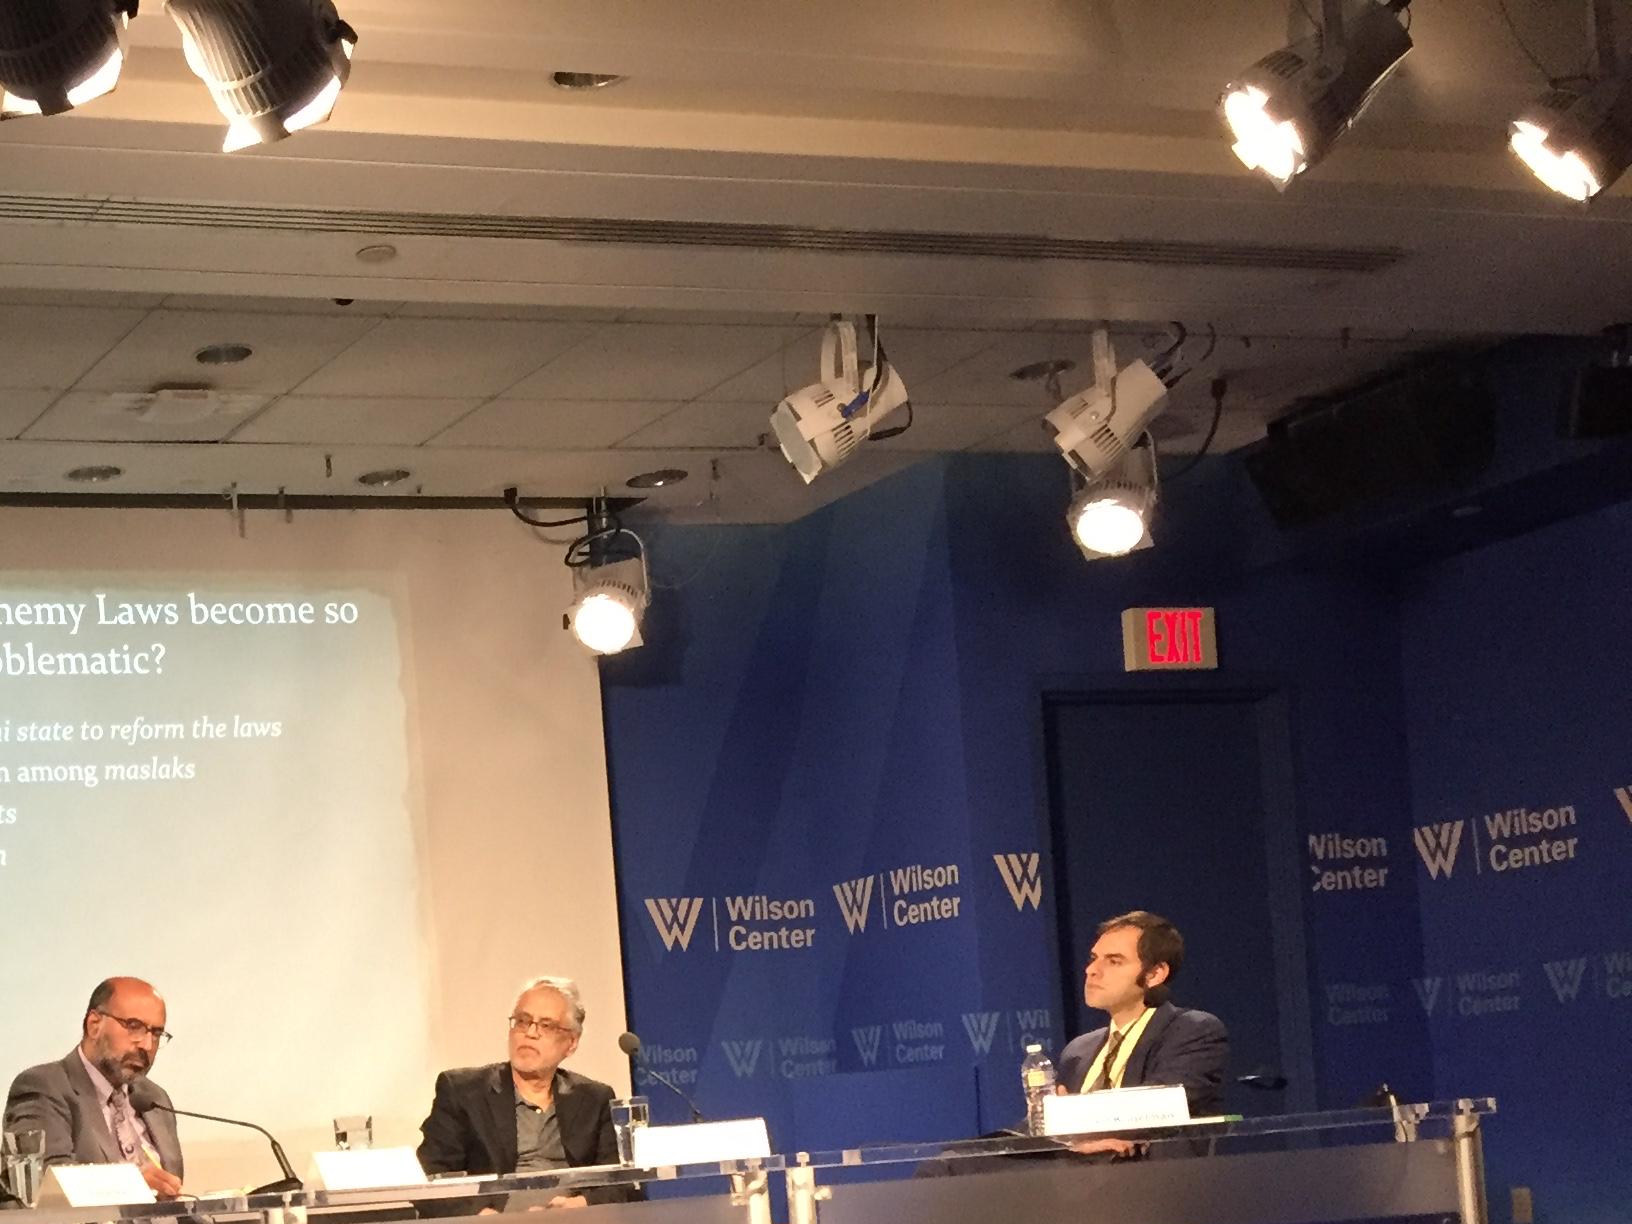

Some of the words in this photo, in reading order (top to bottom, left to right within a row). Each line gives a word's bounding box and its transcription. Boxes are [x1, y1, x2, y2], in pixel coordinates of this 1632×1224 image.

[96, 592, 179, 626] Laws
[187, 591, 315, 625] become
[325, 602, 359, 625] so
[1146, 610, 1202, 664] EXIT
[16, 720, 74, 744] state
[80, 721, 104, 743] to
[109, 716, 185, 746] reform
[192, 717, 228, 742] the
[232, 715, 282, 740] laws
[17, 765, 99, 788] among
[104, 757, 196, 783] maslaks
[1484, 805, 1576, 841] Wilson
[1488, 836, 1578, 872] Center
[889, 864, 959, 897] Wilson
[725, 895, 815, 922] Wilson
[893, 894, 961, 927] Center
[728, 925, 816, 951] Center
[893, 1019, 944, 1041] Wilson
[895, 1040, 944, 1063] Center
